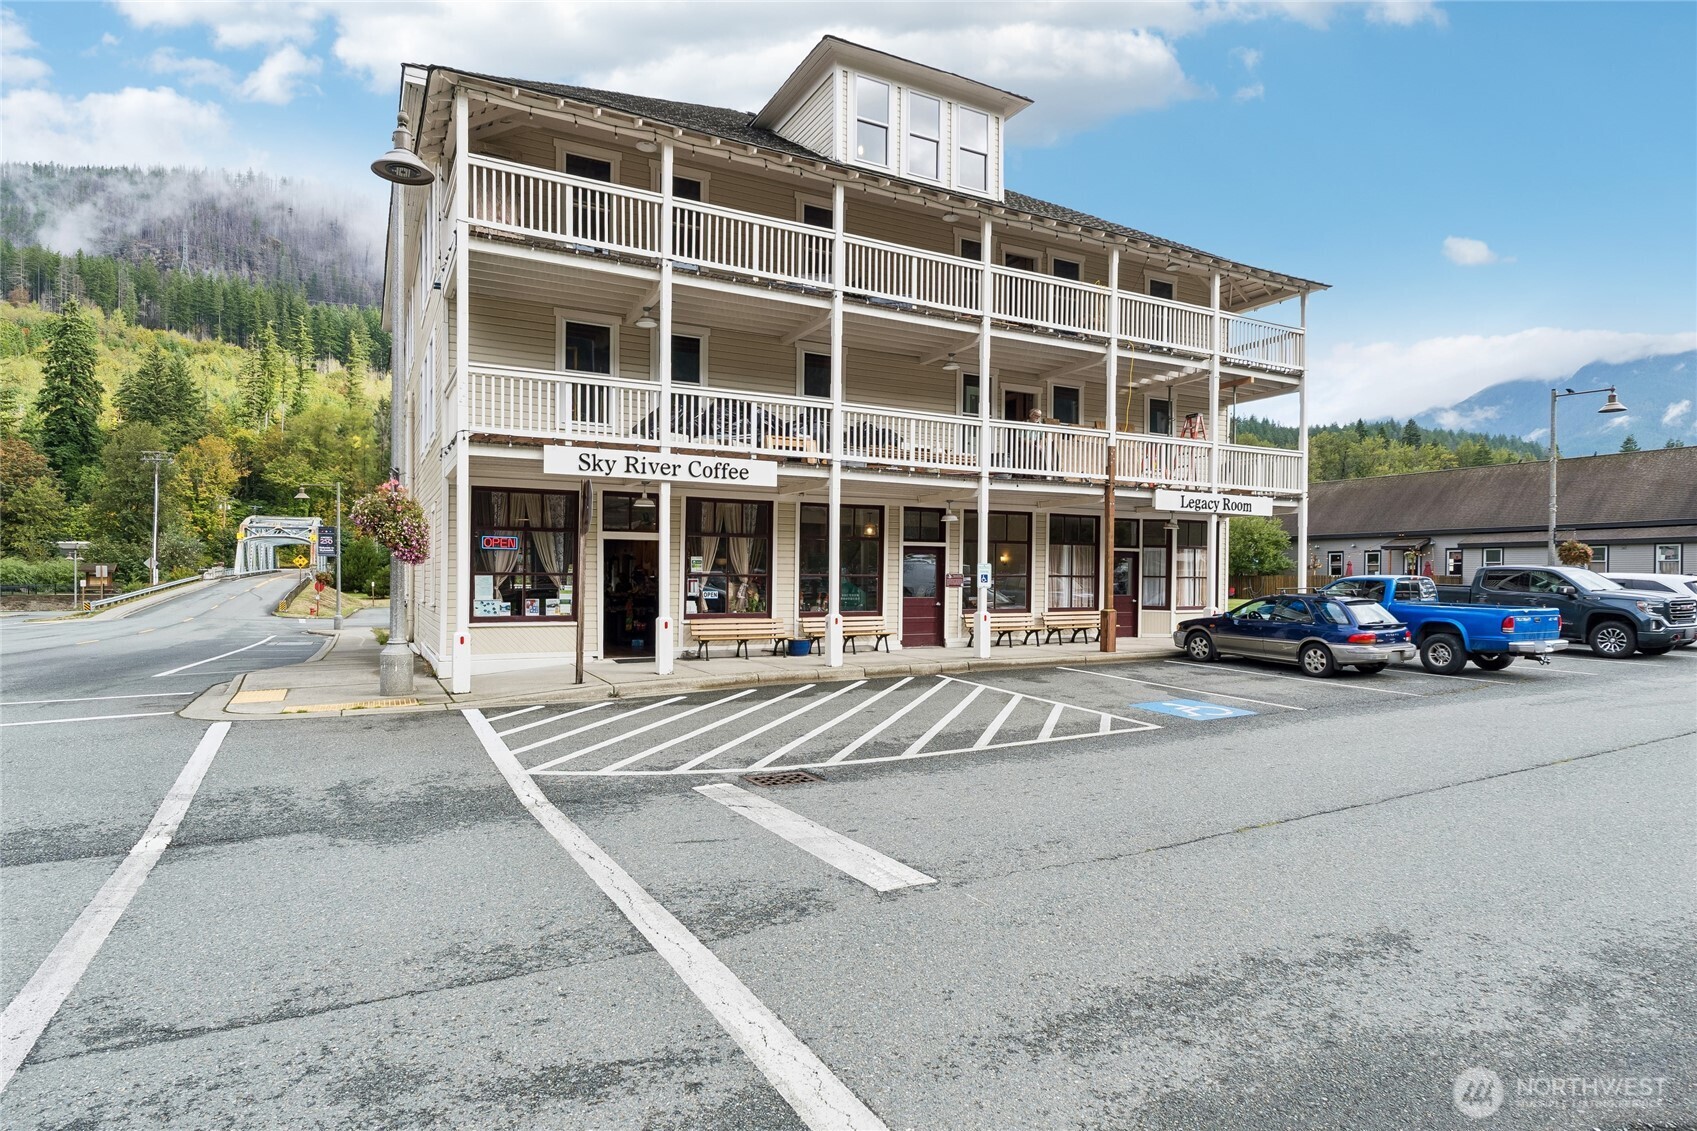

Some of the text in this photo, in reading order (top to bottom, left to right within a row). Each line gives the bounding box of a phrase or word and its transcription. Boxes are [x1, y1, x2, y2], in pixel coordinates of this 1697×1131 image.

[578, 452, 750, 480] Sky River Coffee
[1180, 495, 1252, 513] Legacy Room
[483, 537, 516, 548] OPEN
